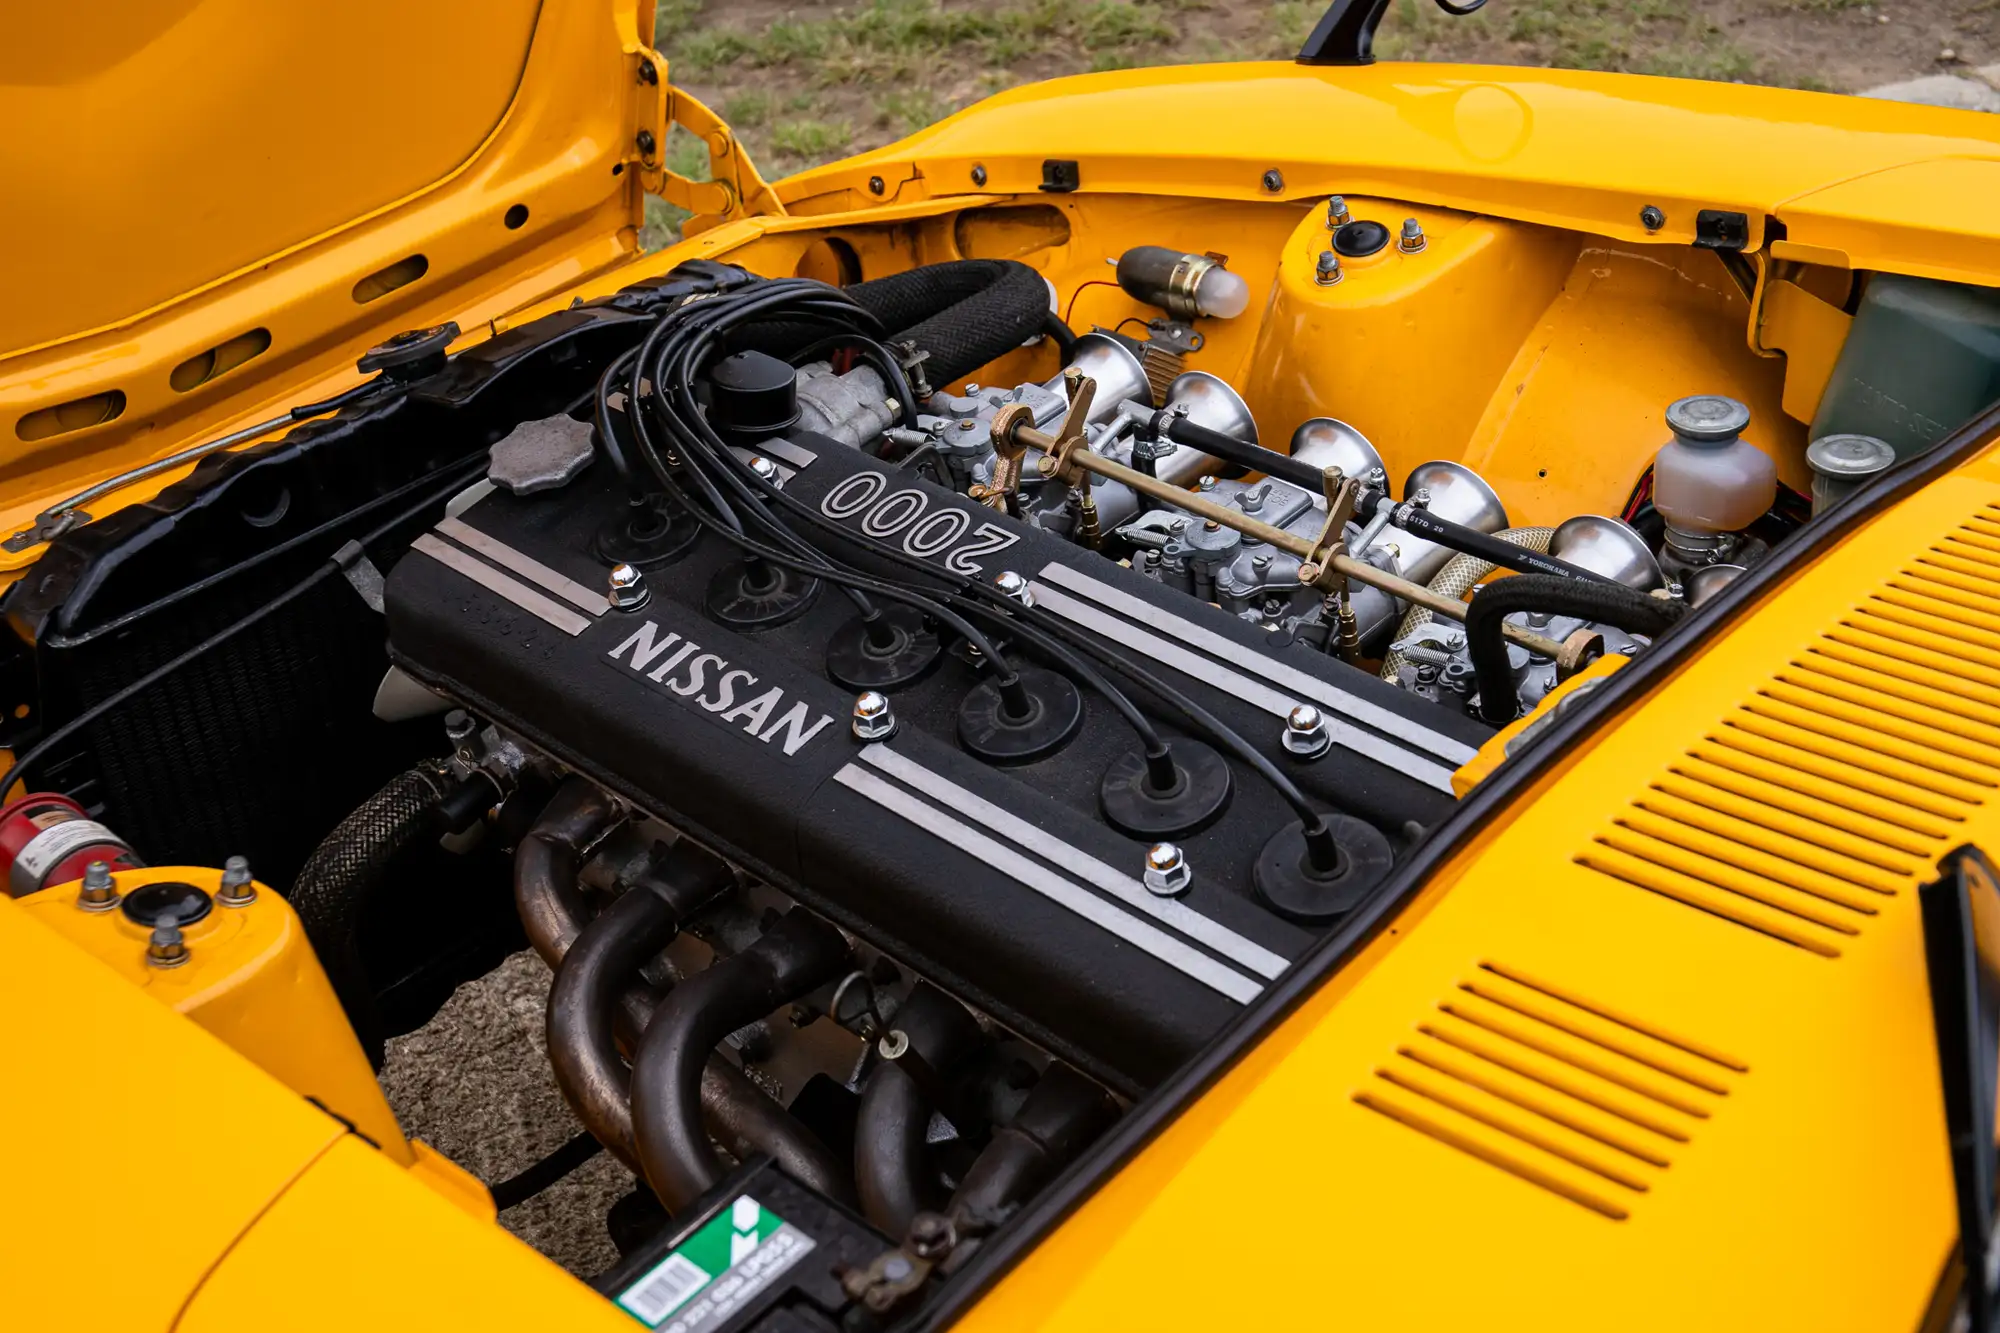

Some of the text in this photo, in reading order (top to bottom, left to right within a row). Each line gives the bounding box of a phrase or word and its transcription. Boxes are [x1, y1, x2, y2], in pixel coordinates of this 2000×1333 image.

[820, 470, 1021, 577] 2000
[1528, 558, 1570, 577] YOKOHAMA
[608, 620, 835, 757] NISSAN
